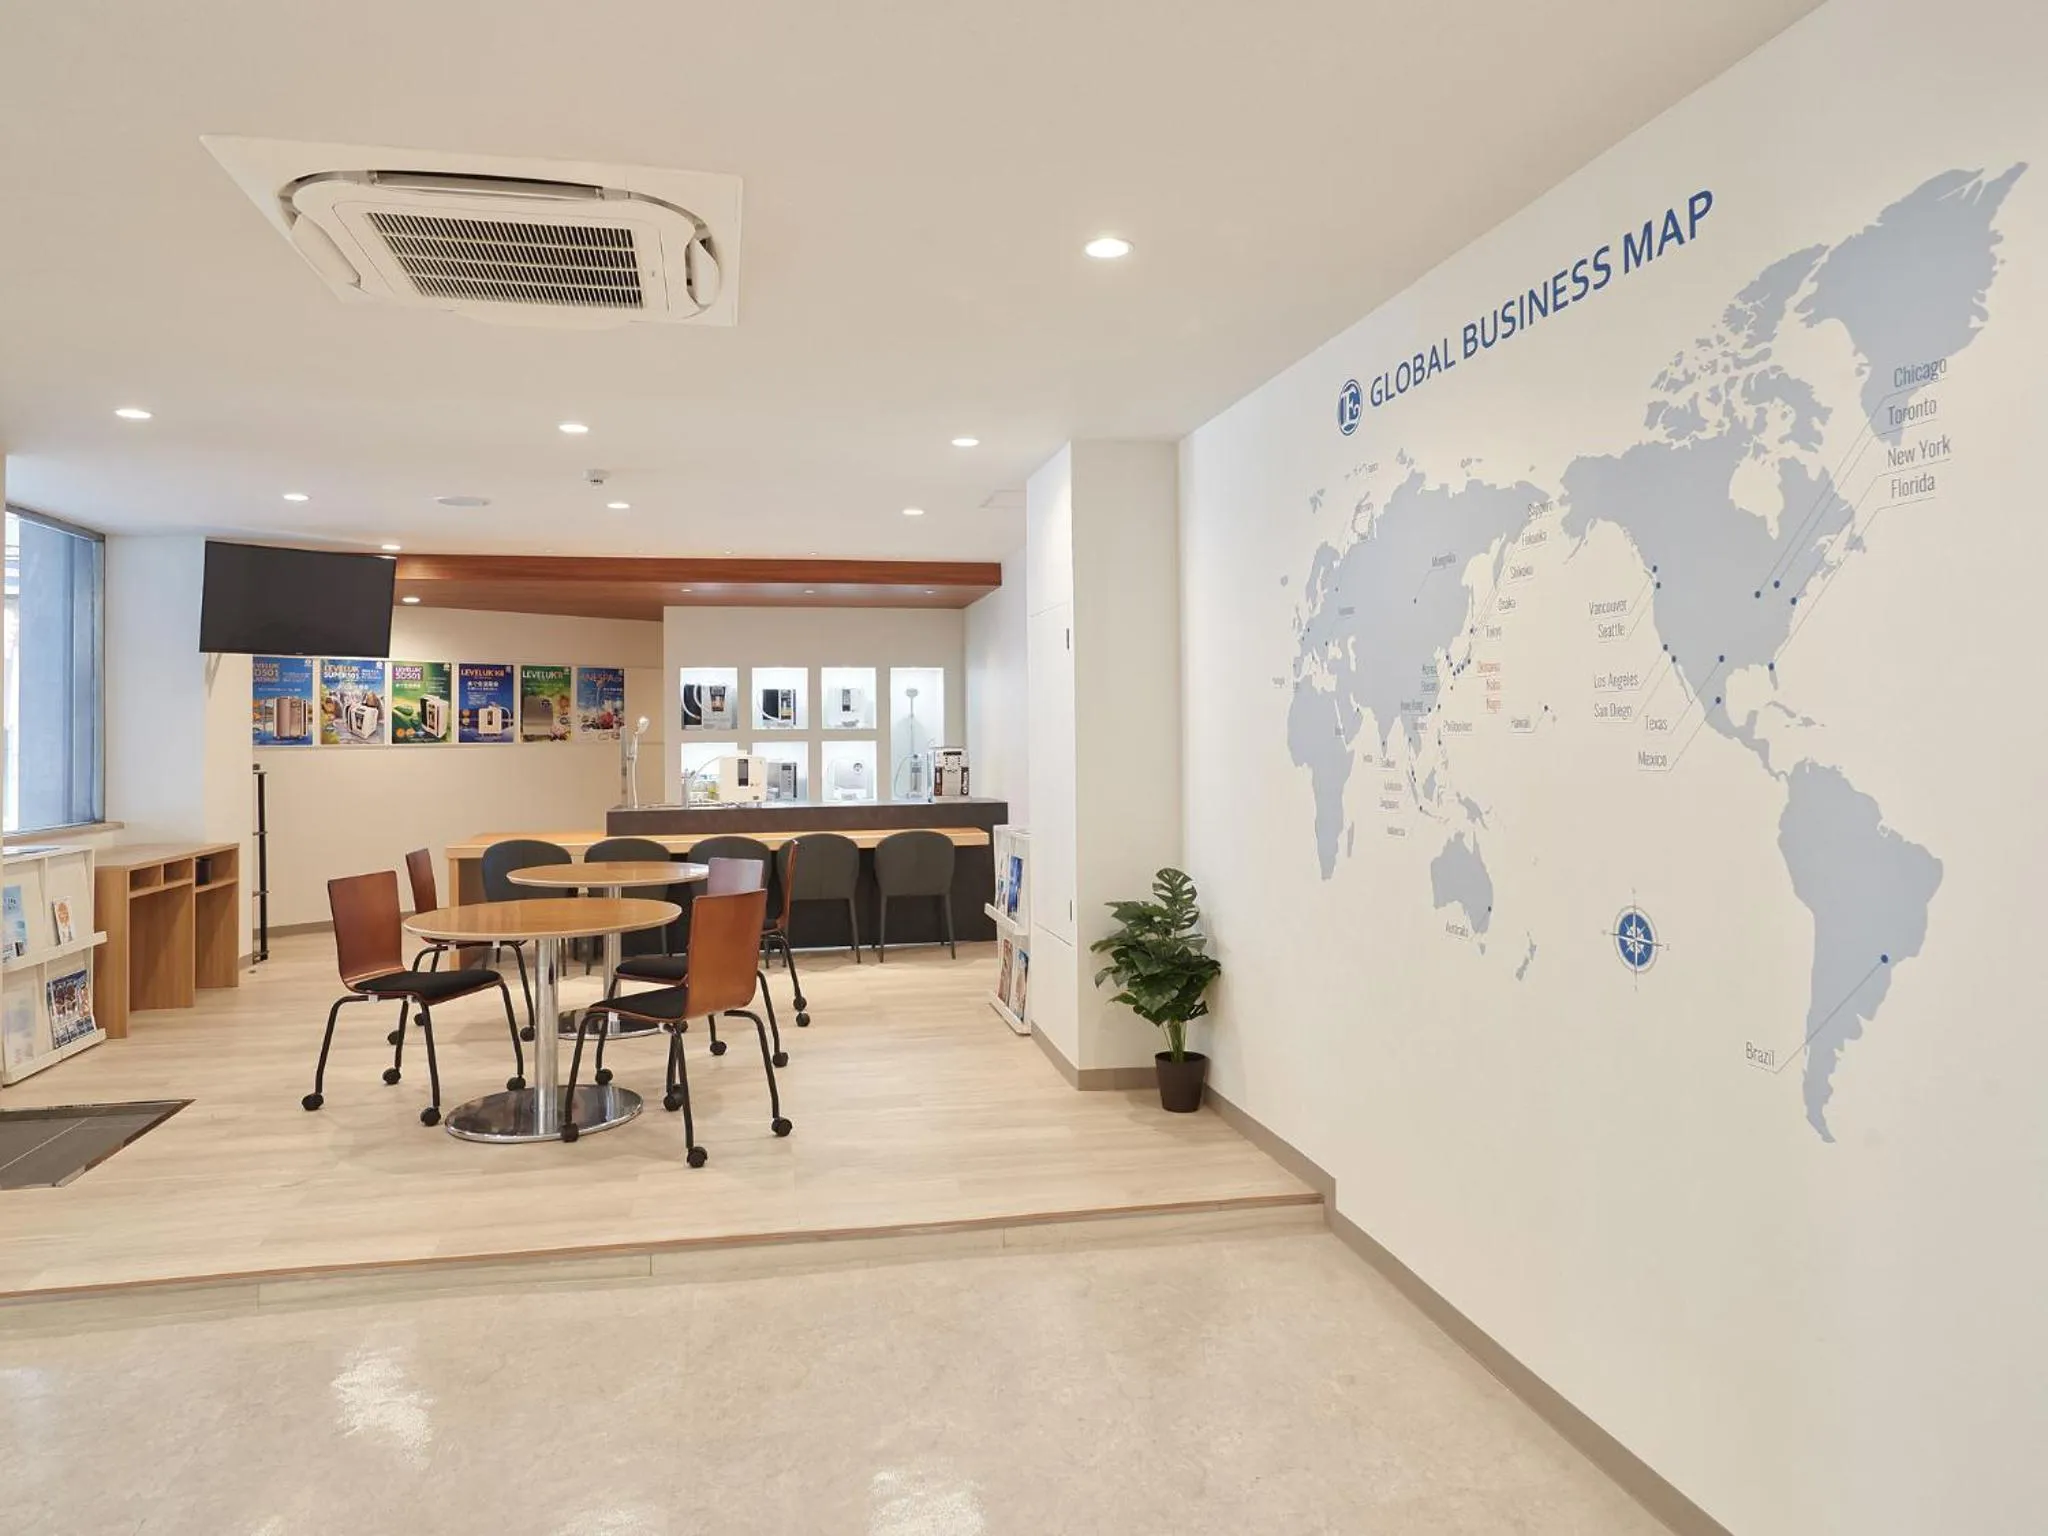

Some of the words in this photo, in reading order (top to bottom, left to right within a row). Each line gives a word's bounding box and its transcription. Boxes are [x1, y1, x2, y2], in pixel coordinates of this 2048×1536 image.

[1370, 338, 1456, 407] GLOBAL
[1463, 245, 1612, 360] BUSINESS
[1623, 190, 1713, 274] MAP
[1894, 358, 1947, 388] Chicago
[1889, 398, 1937, 425] Toronto
[1887, 447, 1915, 468] New
[1919, 434, 1952, 460] York
[1891, 472, 1935, 499] Florida
[1589, 600, 1627, 616] Vancouver
[1598, 623, 1625, 638] Seattle
[1594, 675, 1606, 689] Los
[1608, 672, 1639, 690] Angeles
[1594, 703, 1607, 718] San
[1609, 703, 1632, 720] Diego
[1645, 716, 1668, 731] Texas
[1638, 752, 1667, 767] Mexico
[1745, 1041, 1775, 1067] Brazil
